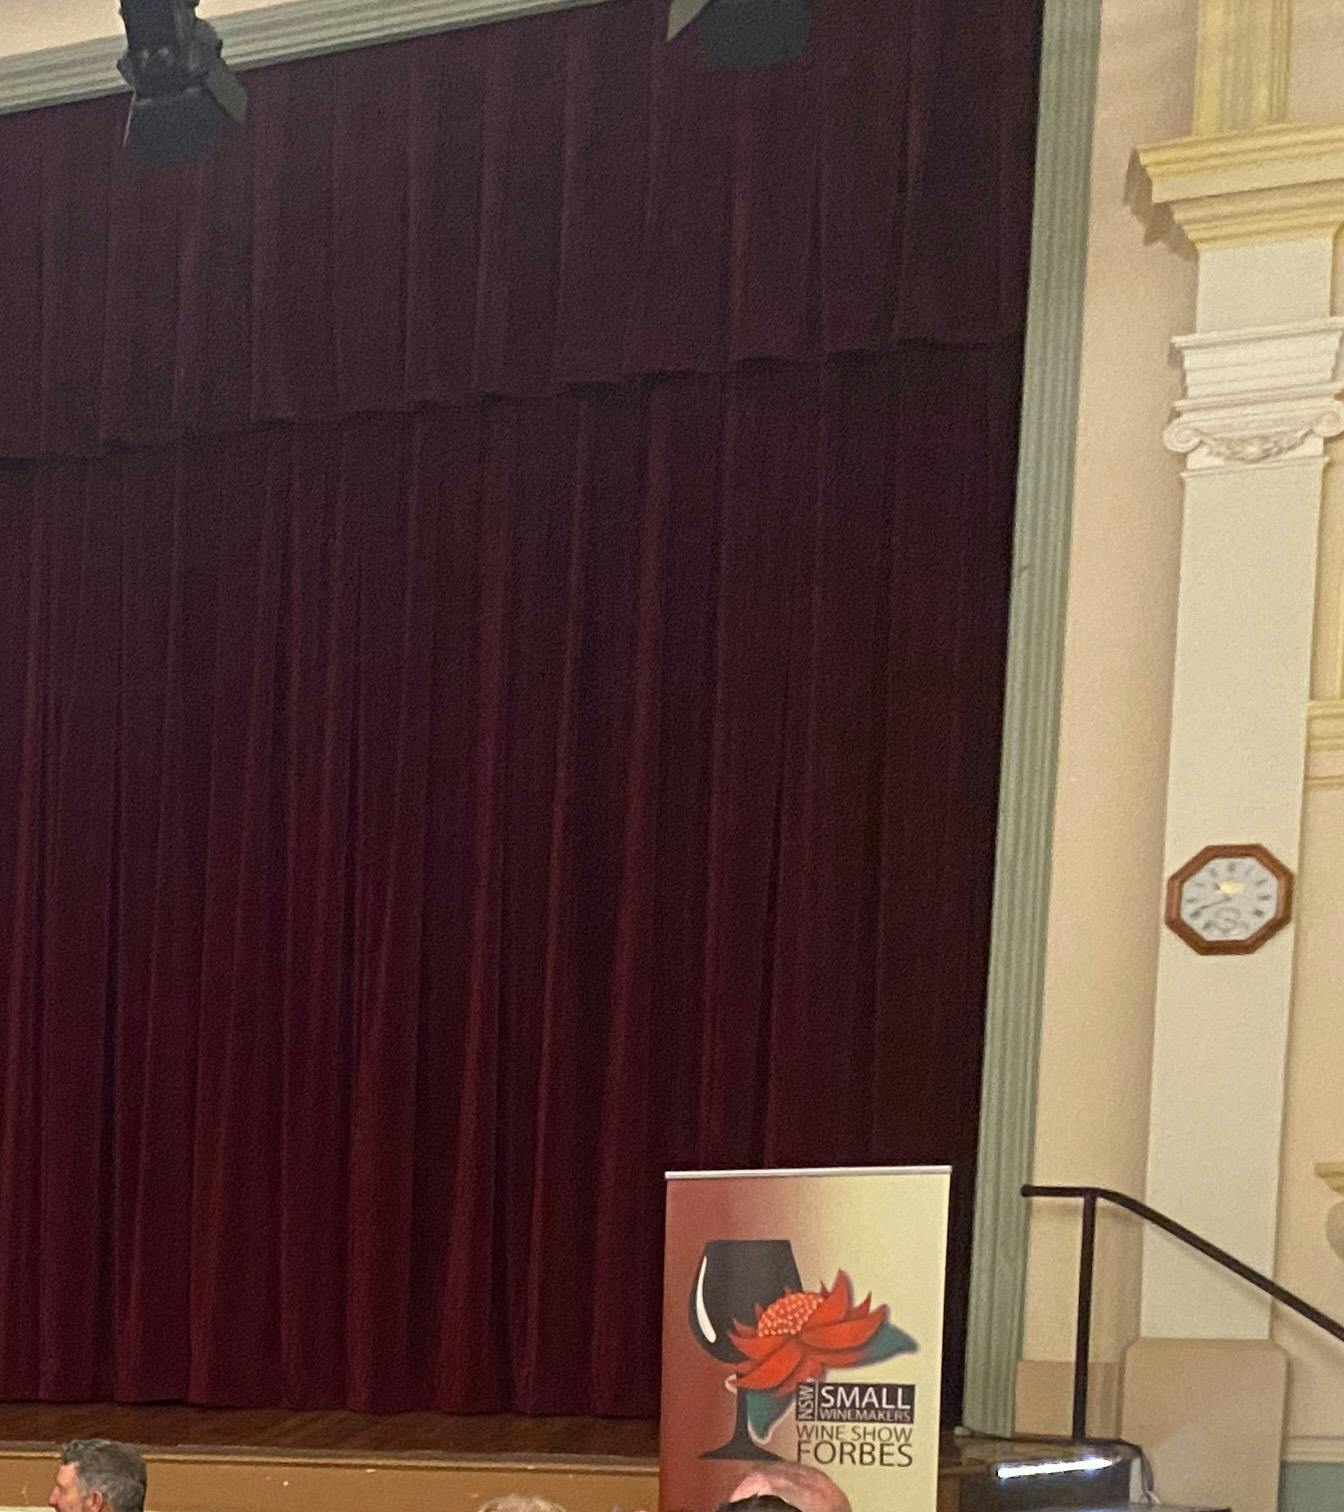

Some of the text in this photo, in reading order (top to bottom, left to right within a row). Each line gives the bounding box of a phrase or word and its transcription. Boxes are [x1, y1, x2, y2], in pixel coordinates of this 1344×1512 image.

[798, 1384, 814, 1420] NSW
[820, 1386, 911, 1409] SMALL
[819, 1409, 912, 1422] WINEMAKERS
[796, 1424, 913, 1443] WINE SHOW
[797, 1440, 913, 1468] FORBES
